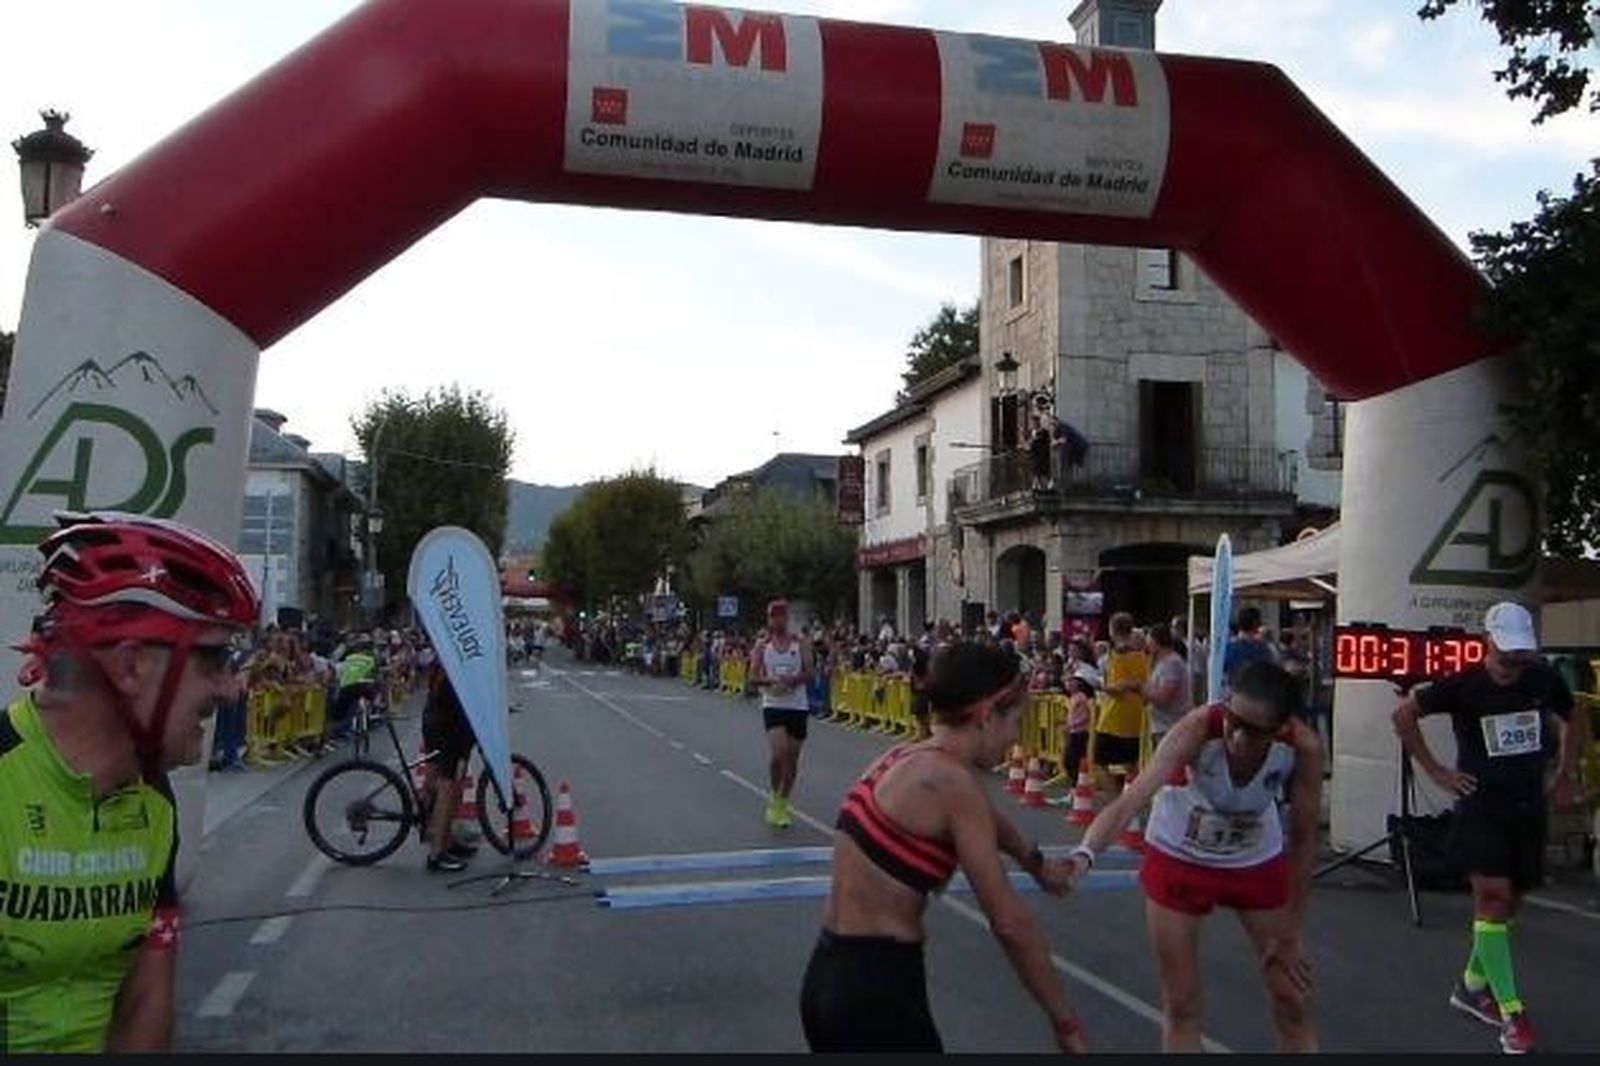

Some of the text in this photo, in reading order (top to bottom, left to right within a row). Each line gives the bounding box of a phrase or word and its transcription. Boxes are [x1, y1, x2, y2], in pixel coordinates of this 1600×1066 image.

[581, 128, 803, 163] Comunidad de Madrid
[948, 161, 1149, 194] Comunidad de Madrid
[1410, 469, 1541, 589] AD
[1500, 726, 1538, 746] 286
